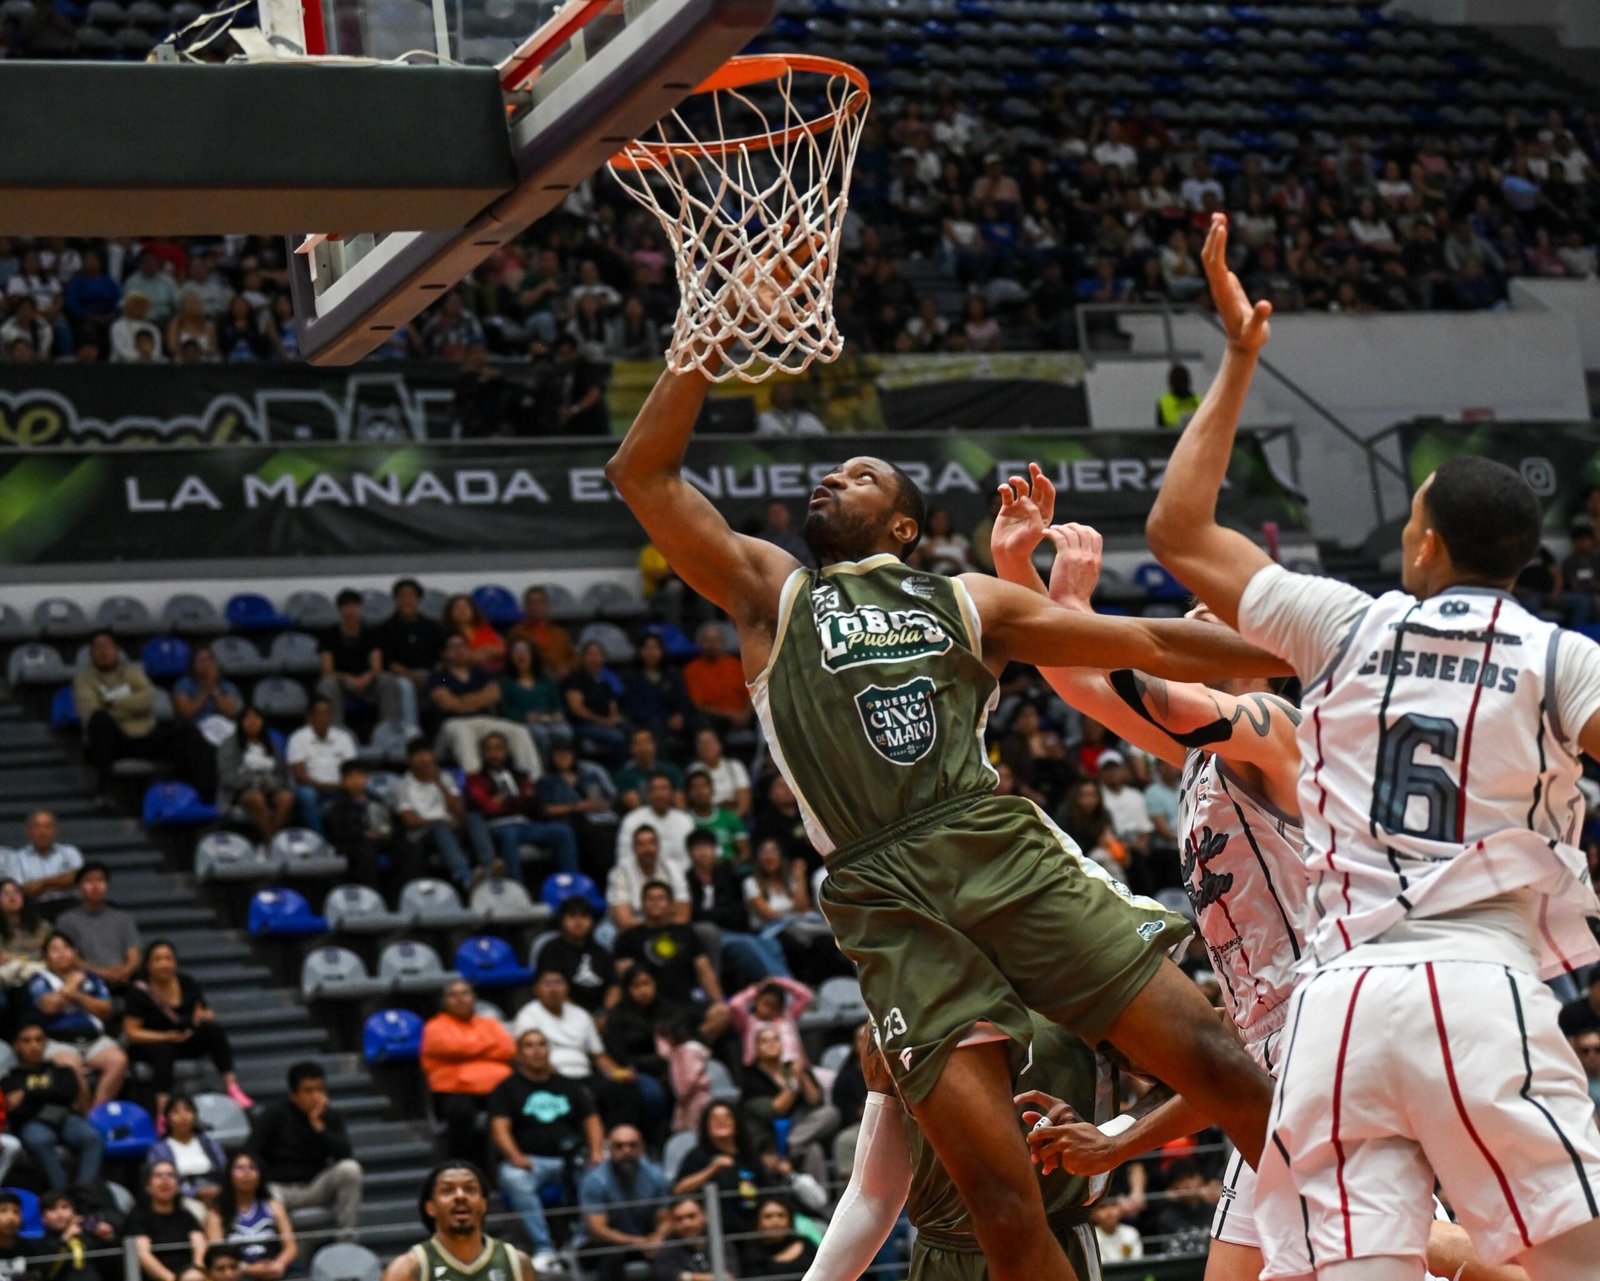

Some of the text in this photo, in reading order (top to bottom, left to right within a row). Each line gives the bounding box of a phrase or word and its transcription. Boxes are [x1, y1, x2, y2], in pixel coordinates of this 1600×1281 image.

[126, 475, 223, 512] LA
[244, 467, 549, 508] MANADA
[568, 467, 625, 502] E
[846, 627, 923, 650] Puebla
[874, 691, 925, 709] PUEBLA
[885, 720, 931, 747] MAYO
[1371, 712, 1460, 843] 6
[883, 1007, 908, 1043] 23
